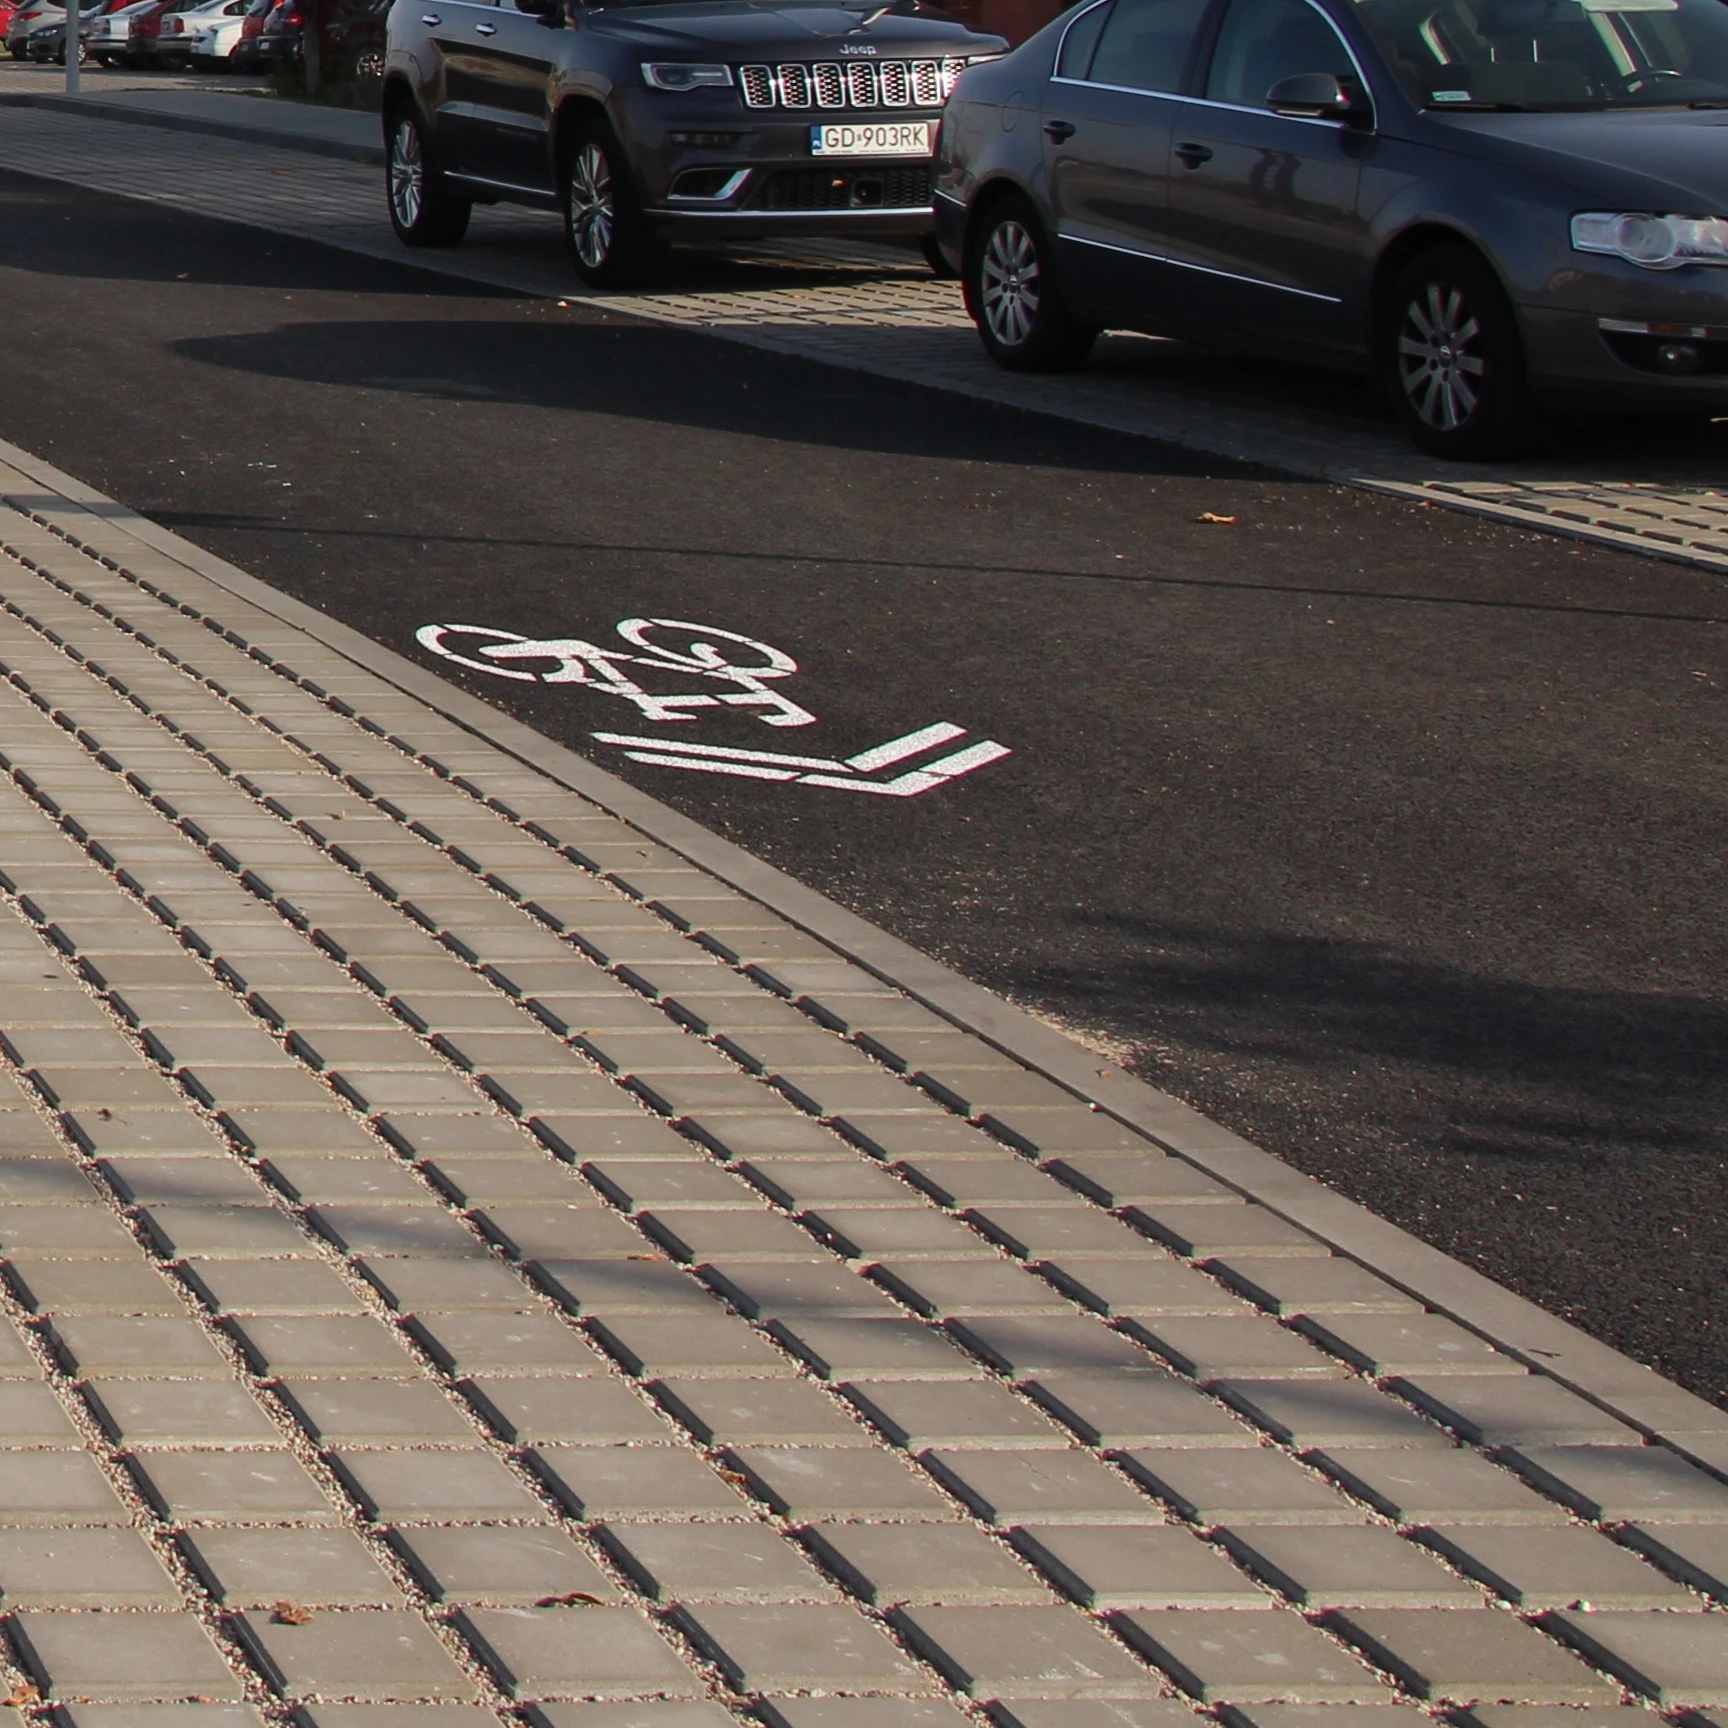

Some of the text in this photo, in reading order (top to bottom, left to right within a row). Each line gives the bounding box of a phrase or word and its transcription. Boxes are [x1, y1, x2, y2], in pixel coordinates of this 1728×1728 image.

[839, 43, 877, 56] Jeep
[825, 126, 925, 148] GD 903RK
